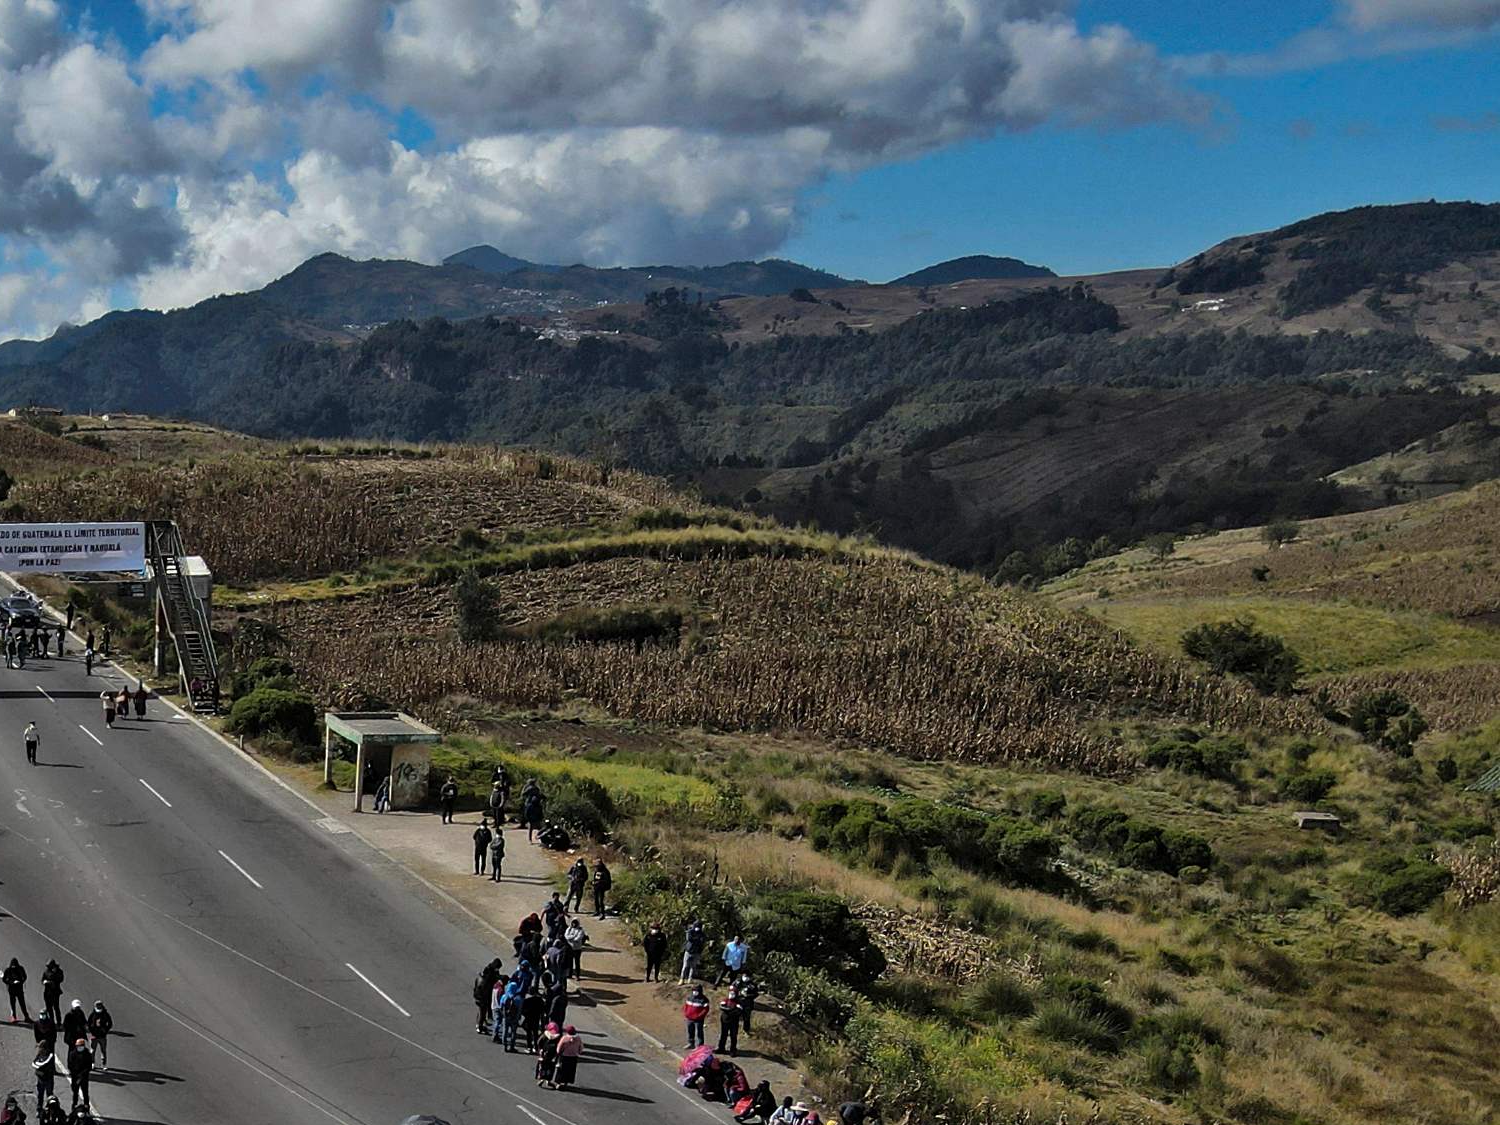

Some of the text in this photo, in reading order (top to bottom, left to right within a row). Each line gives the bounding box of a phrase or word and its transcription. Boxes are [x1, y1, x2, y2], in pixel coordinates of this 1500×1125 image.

[12, 530, 20, 538] DE
[22, 529, 62, 538] GUATEMALA
[64, 529, 72, 538] EL
[98, 527, 140, 536] TERRITORIAL
[4, 546, 38, 554] CATARINA
